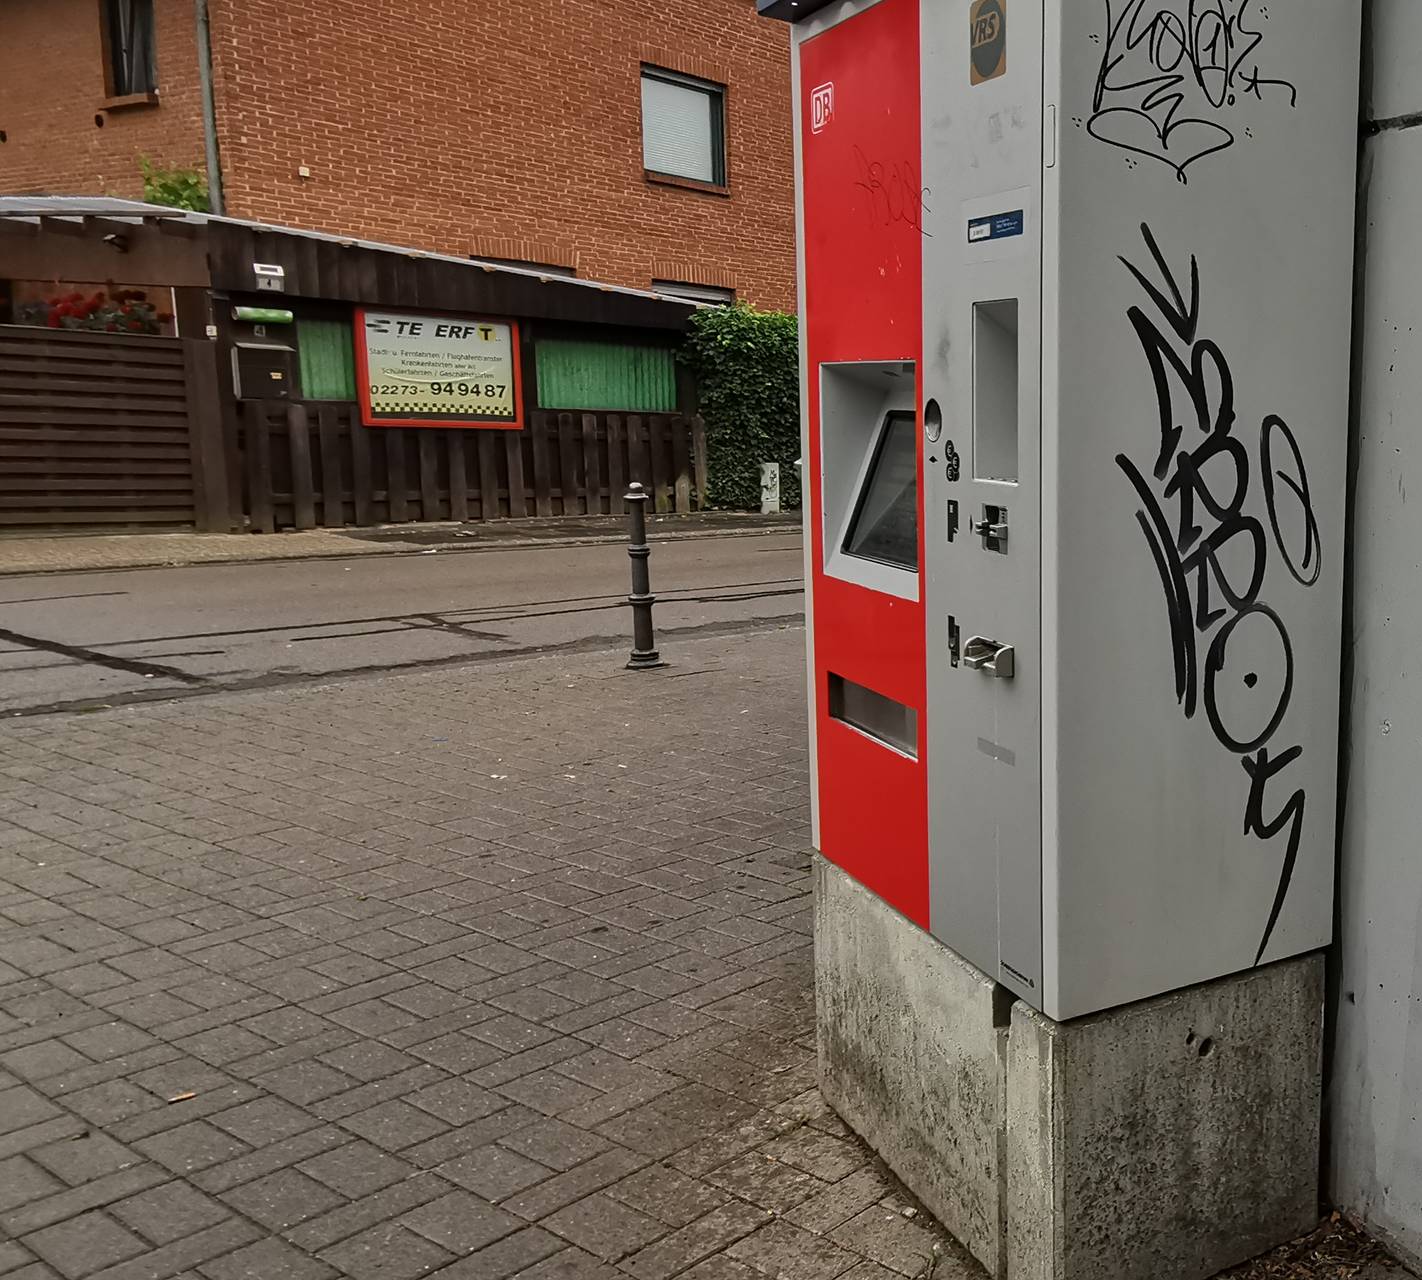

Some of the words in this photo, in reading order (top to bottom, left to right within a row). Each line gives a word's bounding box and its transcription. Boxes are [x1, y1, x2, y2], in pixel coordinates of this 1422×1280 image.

[971, 13, 997, 46] VRS
[813, 88, 833, 127] DB
[370, 384, 425, 395] 02273-
